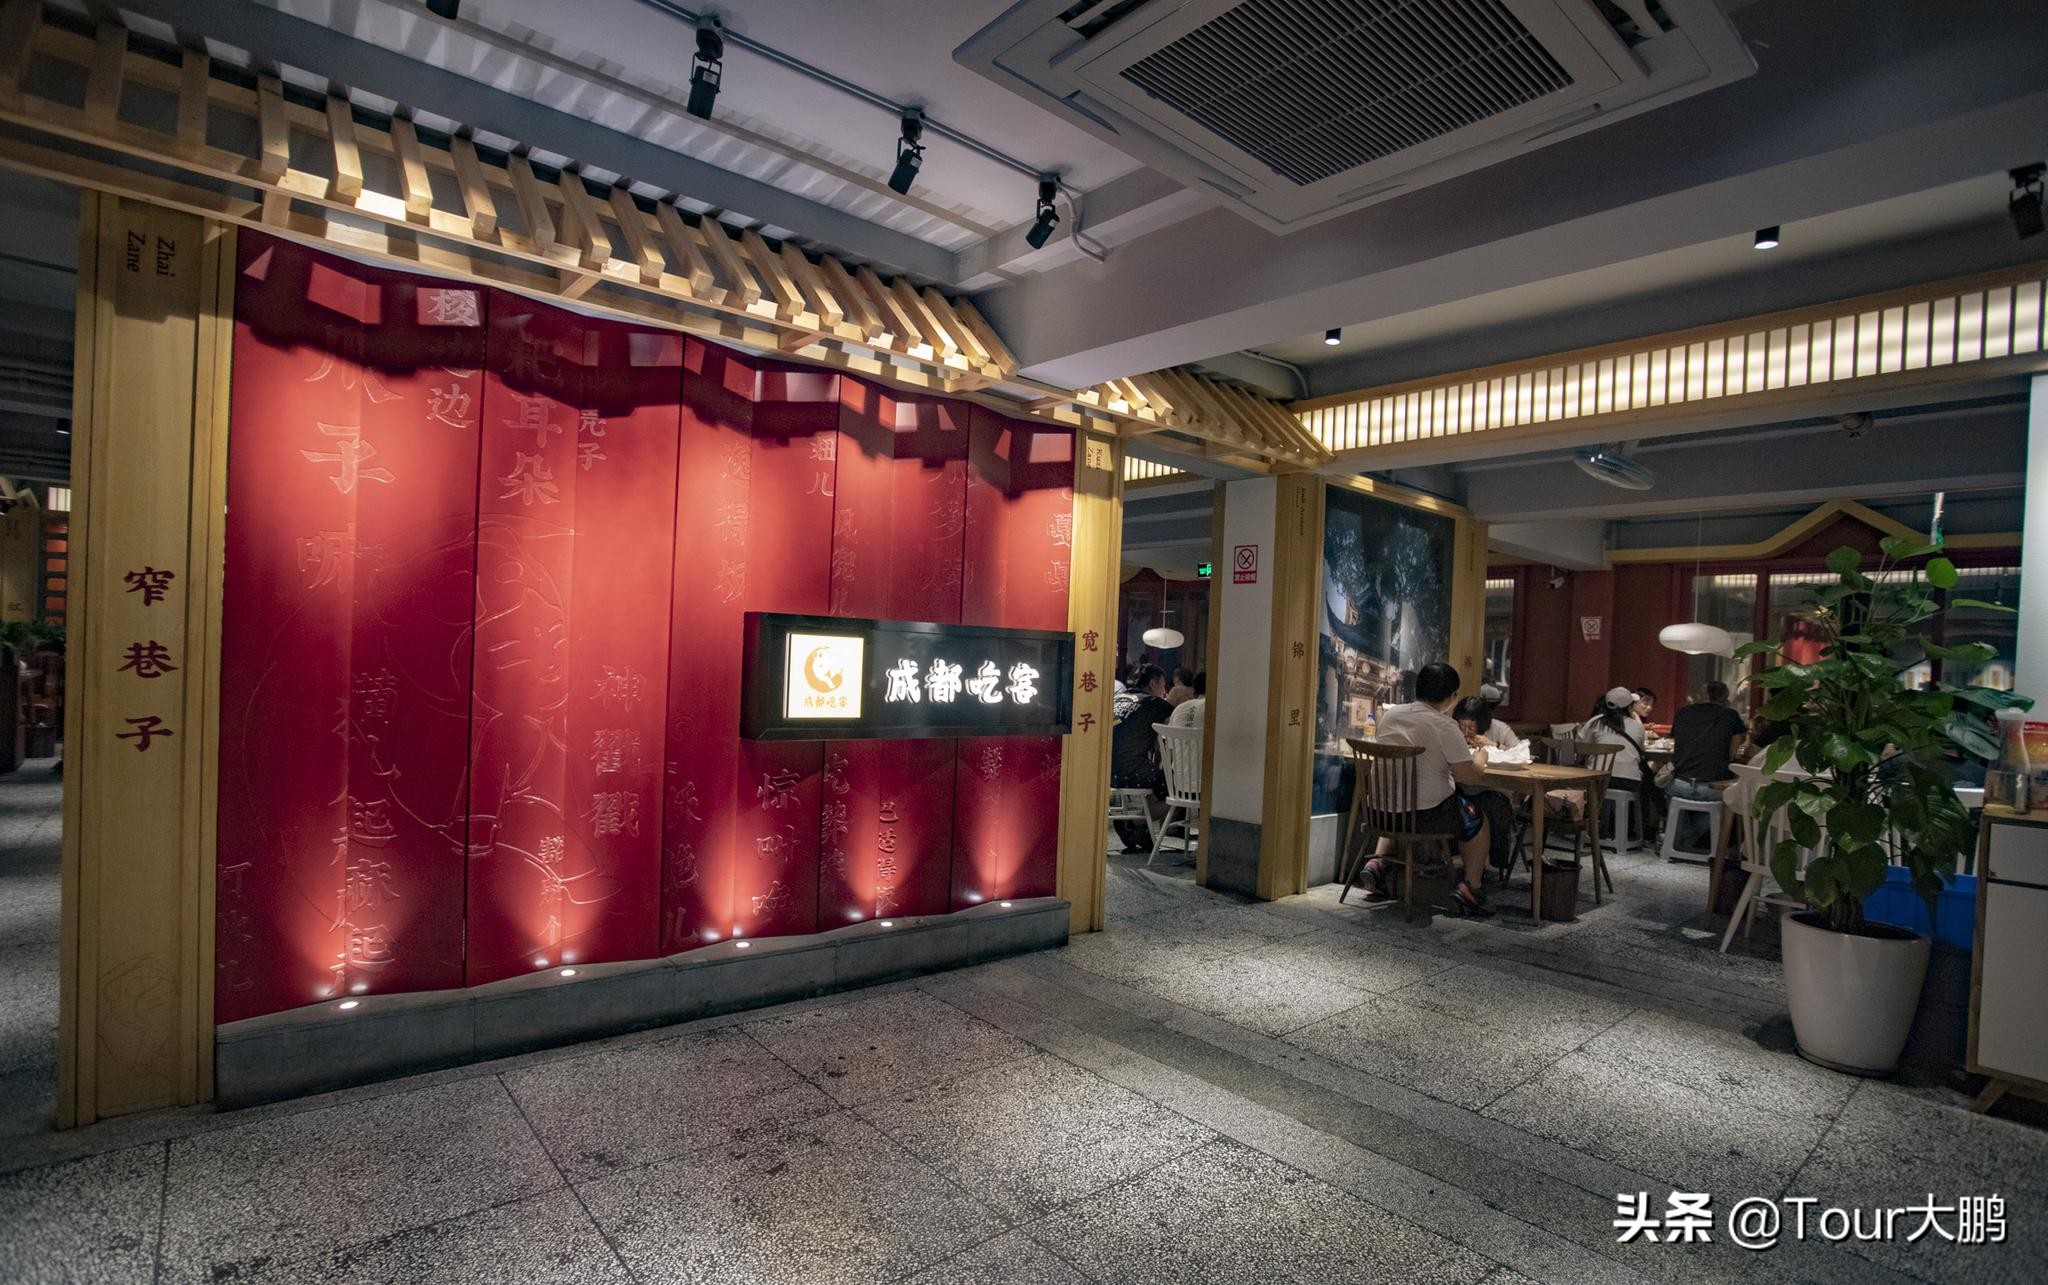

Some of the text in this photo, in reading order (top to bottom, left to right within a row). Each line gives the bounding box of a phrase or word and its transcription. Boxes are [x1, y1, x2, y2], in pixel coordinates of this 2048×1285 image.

[155, 236, 177, 281] Zhai
[115, 565, 178, 753] 窄巷子
[884, 657, 1041, 705] 成都吃客
[1077, 629, 1100, 733] 宽巷子
[1288, 640, 1304, 726] 锦里
[803, 695, 848, 709] 成都吃客
